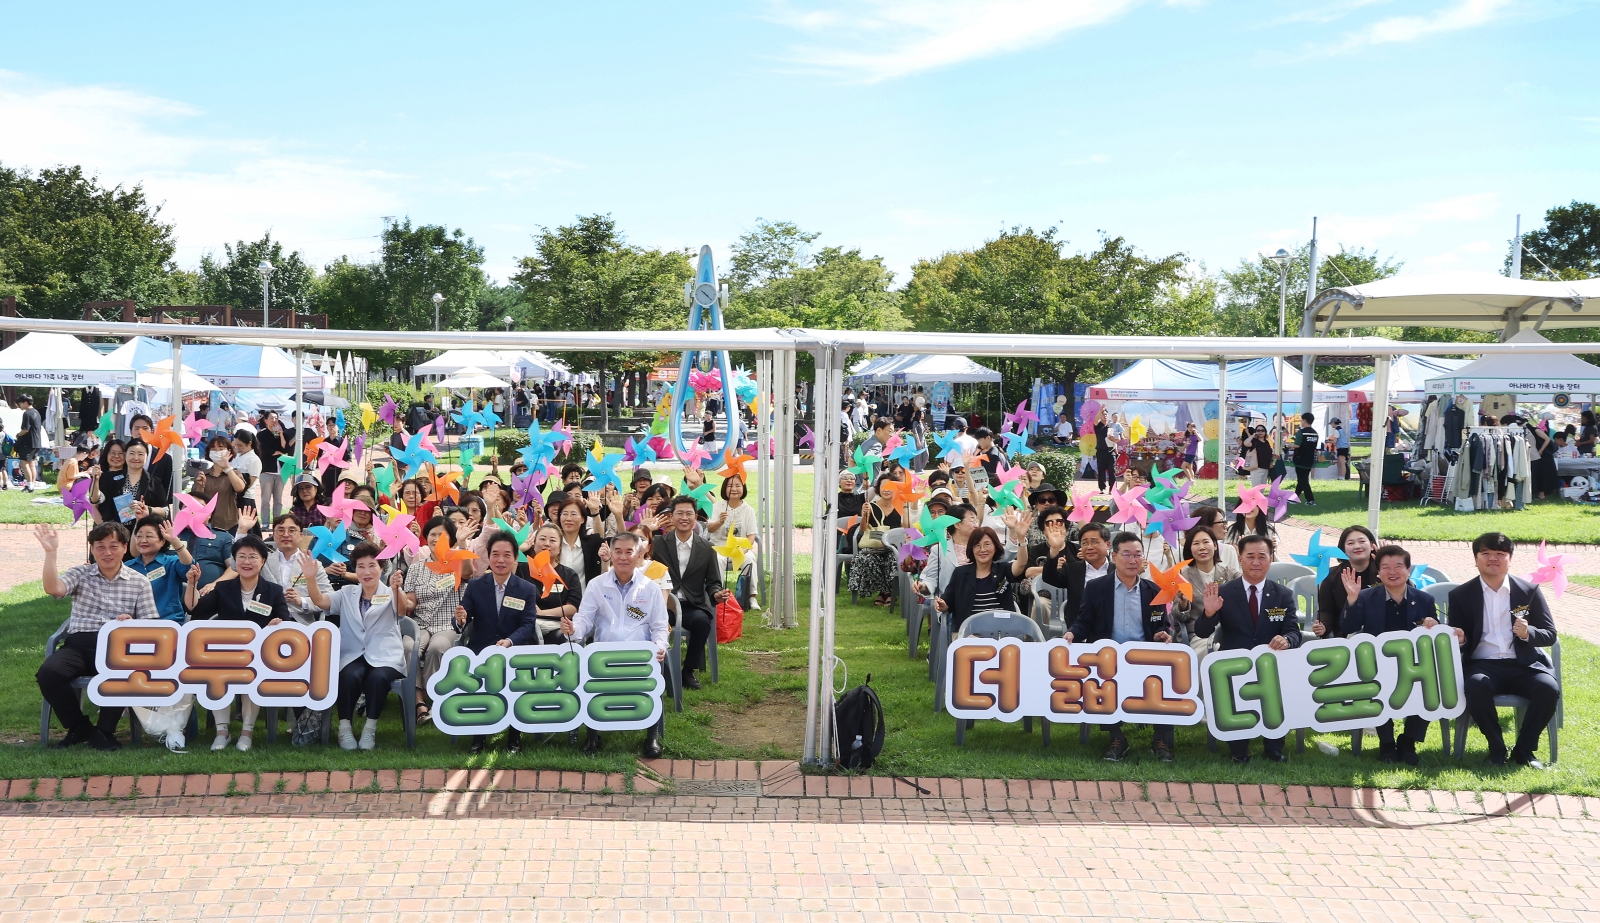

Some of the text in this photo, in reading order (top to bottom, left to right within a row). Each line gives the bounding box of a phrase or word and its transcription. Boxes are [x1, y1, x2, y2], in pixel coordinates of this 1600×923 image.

[57, 373, 69, 381] 나눔
[71, 373, 84, 381] 장터
[1508, 382, 1536, 390] 아나바다
[1566, 383, 1581, 391] 장터
[97, 627, 333, 701] 모두의
[434, 648, 658, 727] 성평등
[952, 644, 1198, 716] 더 넓고
[1208, 632, 1459, 731] 더 깊게
